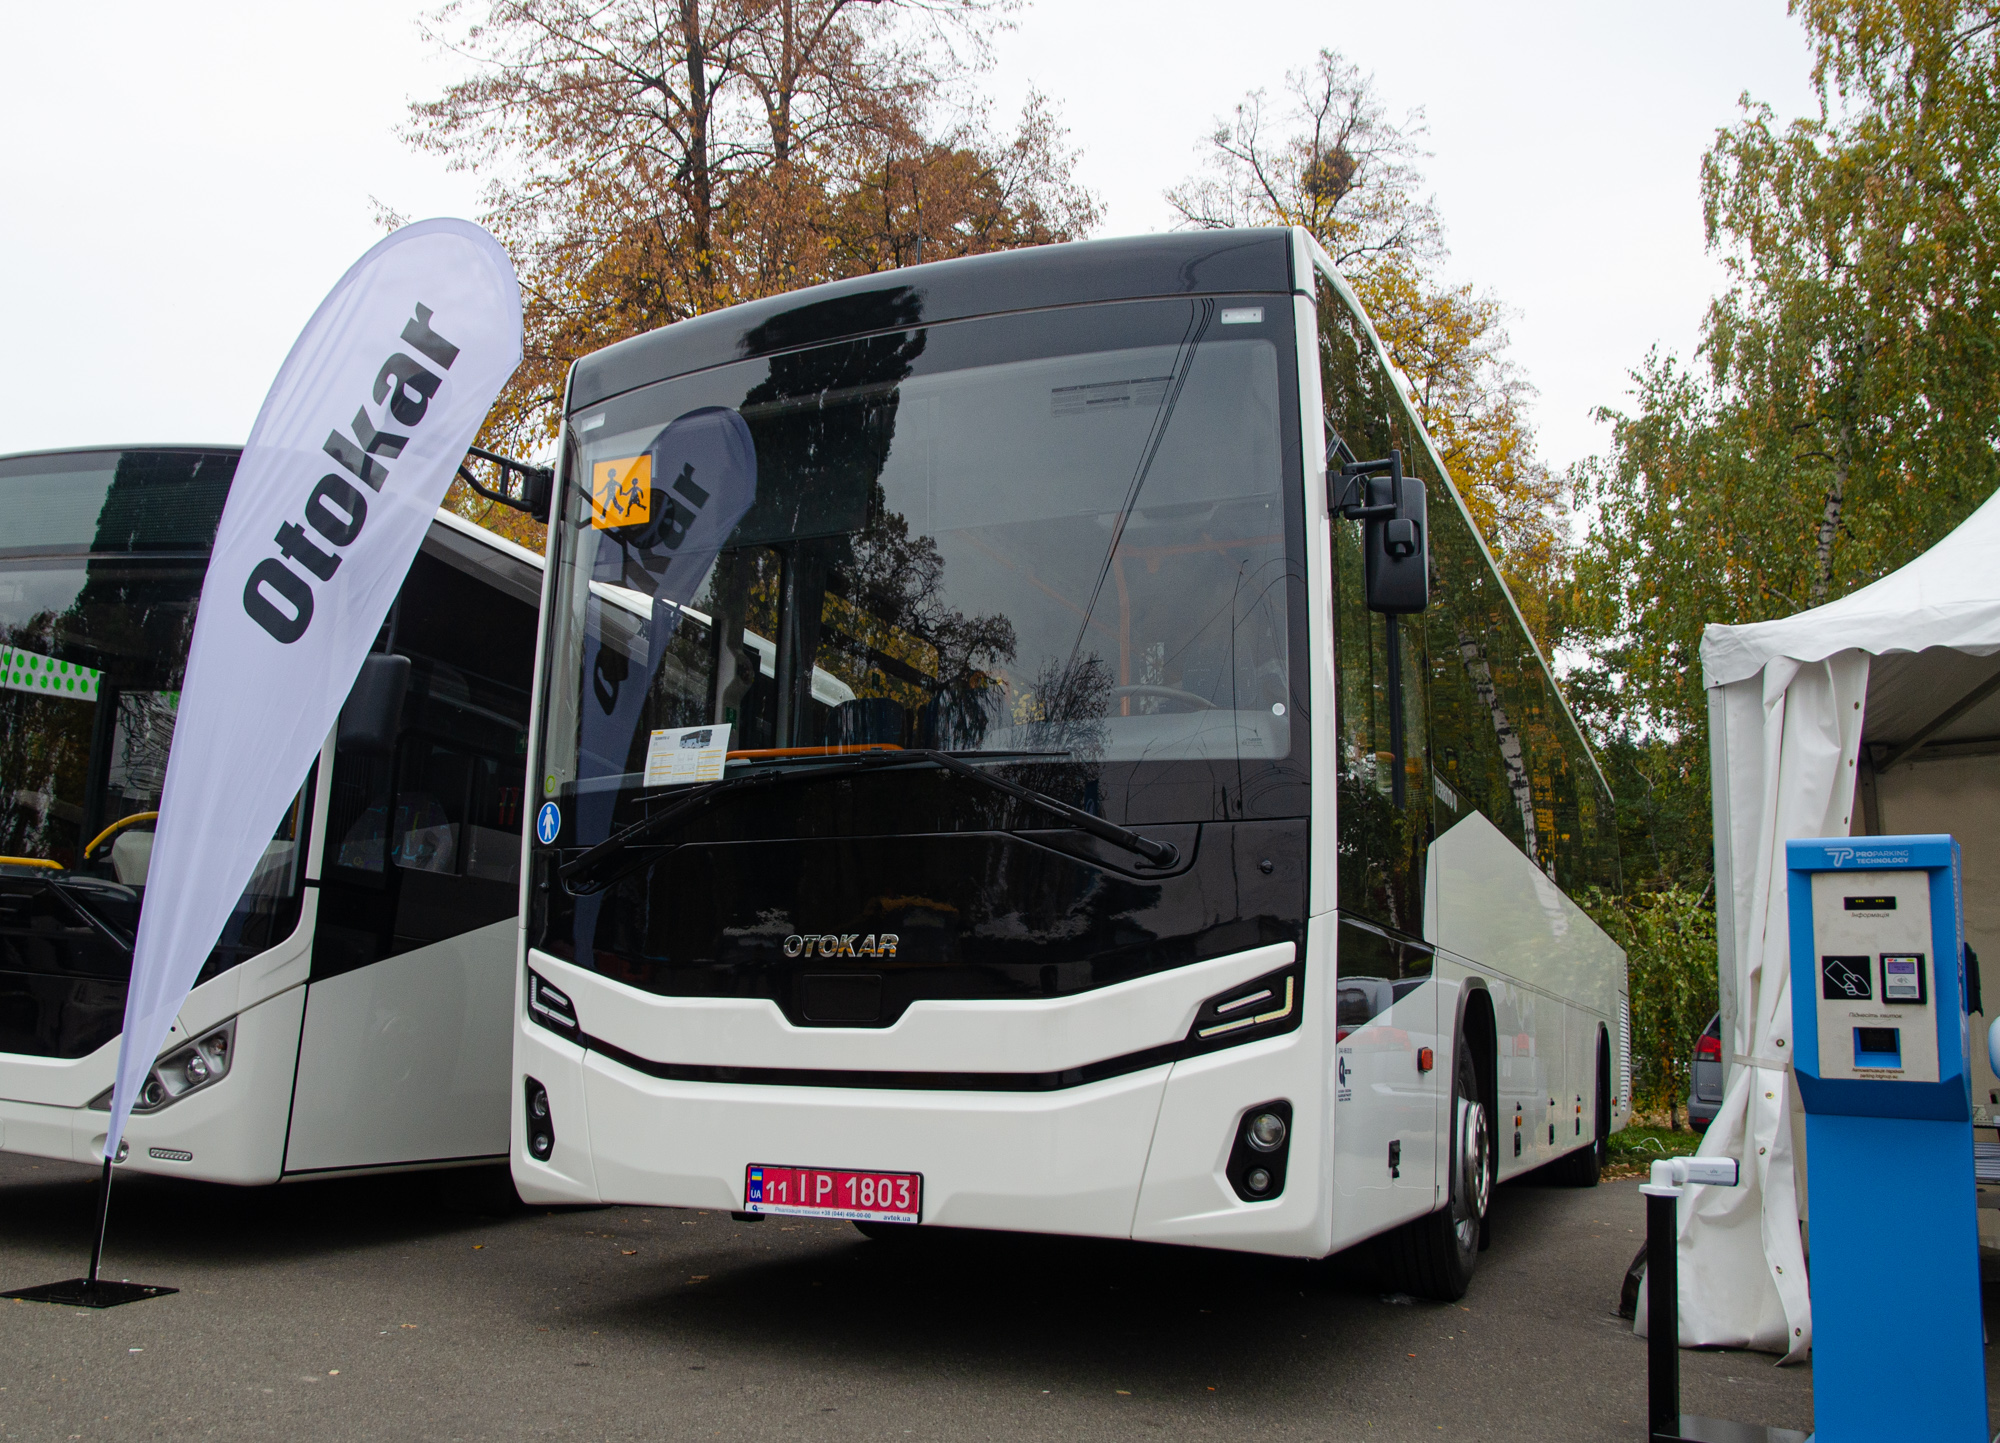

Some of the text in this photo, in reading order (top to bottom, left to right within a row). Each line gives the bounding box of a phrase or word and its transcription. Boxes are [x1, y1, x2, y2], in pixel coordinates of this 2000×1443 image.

[243, 301, 461, 645] Otokar
[1855, 850, 1909, 858] PROPARKING
[783, 933, 900, 958] OTOKAR
[750, 1189, 762, 1199] UA
[766, 1174, 911, 1210] 11 IP 1803
[883, 1214, 911, 1222] avtek.ua
